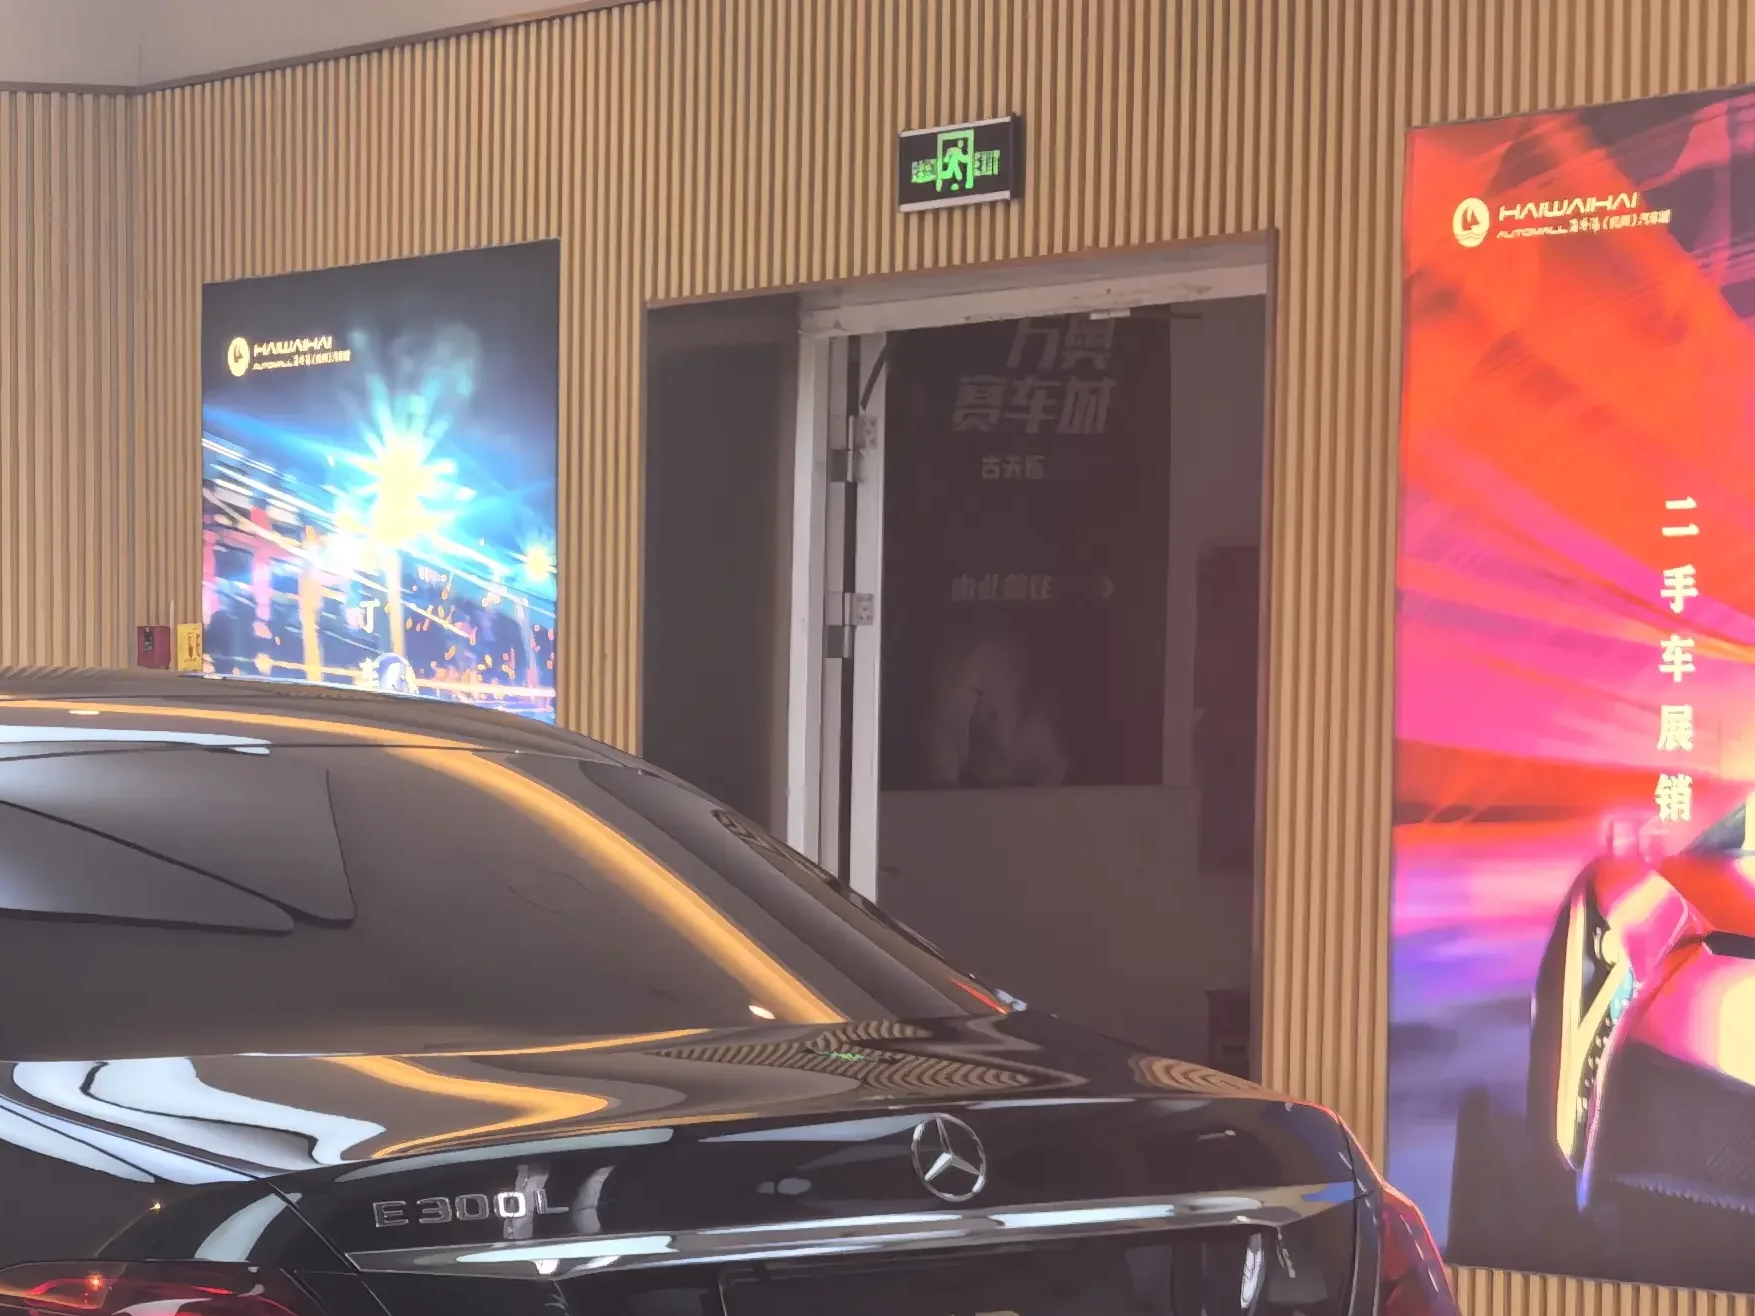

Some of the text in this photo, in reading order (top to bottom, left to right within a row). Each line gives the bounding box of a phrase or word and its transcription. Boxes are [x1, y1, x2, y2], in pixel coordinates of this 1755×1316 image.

[1498, 192, 1637, 221] HAIWAIHAI
[1654, 496, 1700, 823] 二手车展销
